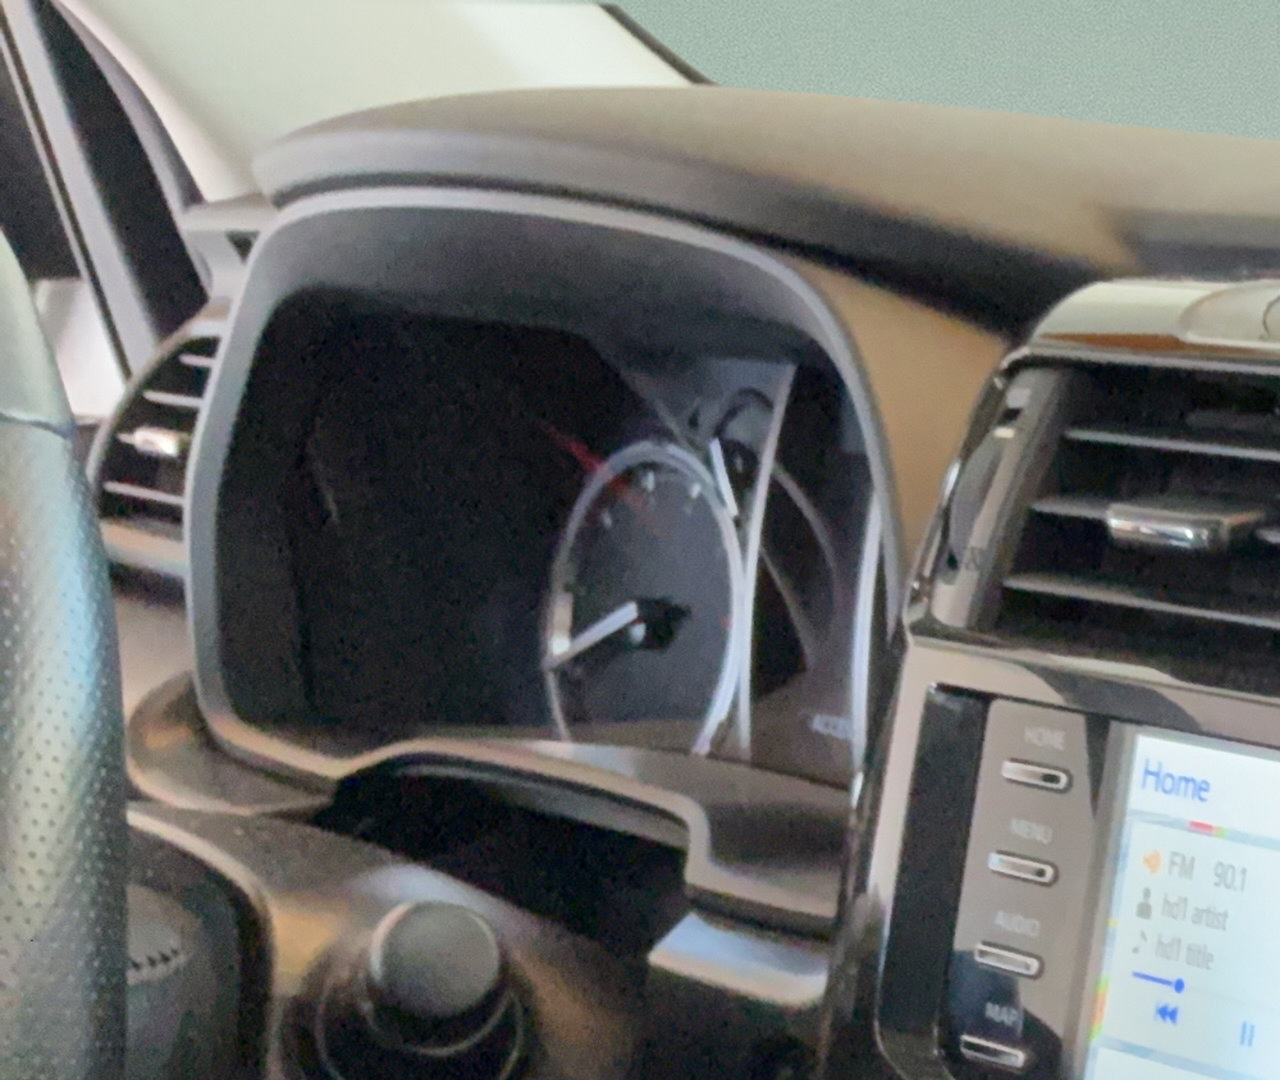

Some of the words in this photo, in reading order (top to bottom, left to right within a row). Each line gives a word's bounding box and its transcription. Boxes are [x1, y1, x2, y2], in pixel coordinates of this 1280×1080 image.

[1140, 757, 1211, 803] Home
[1167, 850, 1195, 880] FM
[1213, 861, 1247, 892] 90.1
[985, 1002, 1019, 1027] MAP
